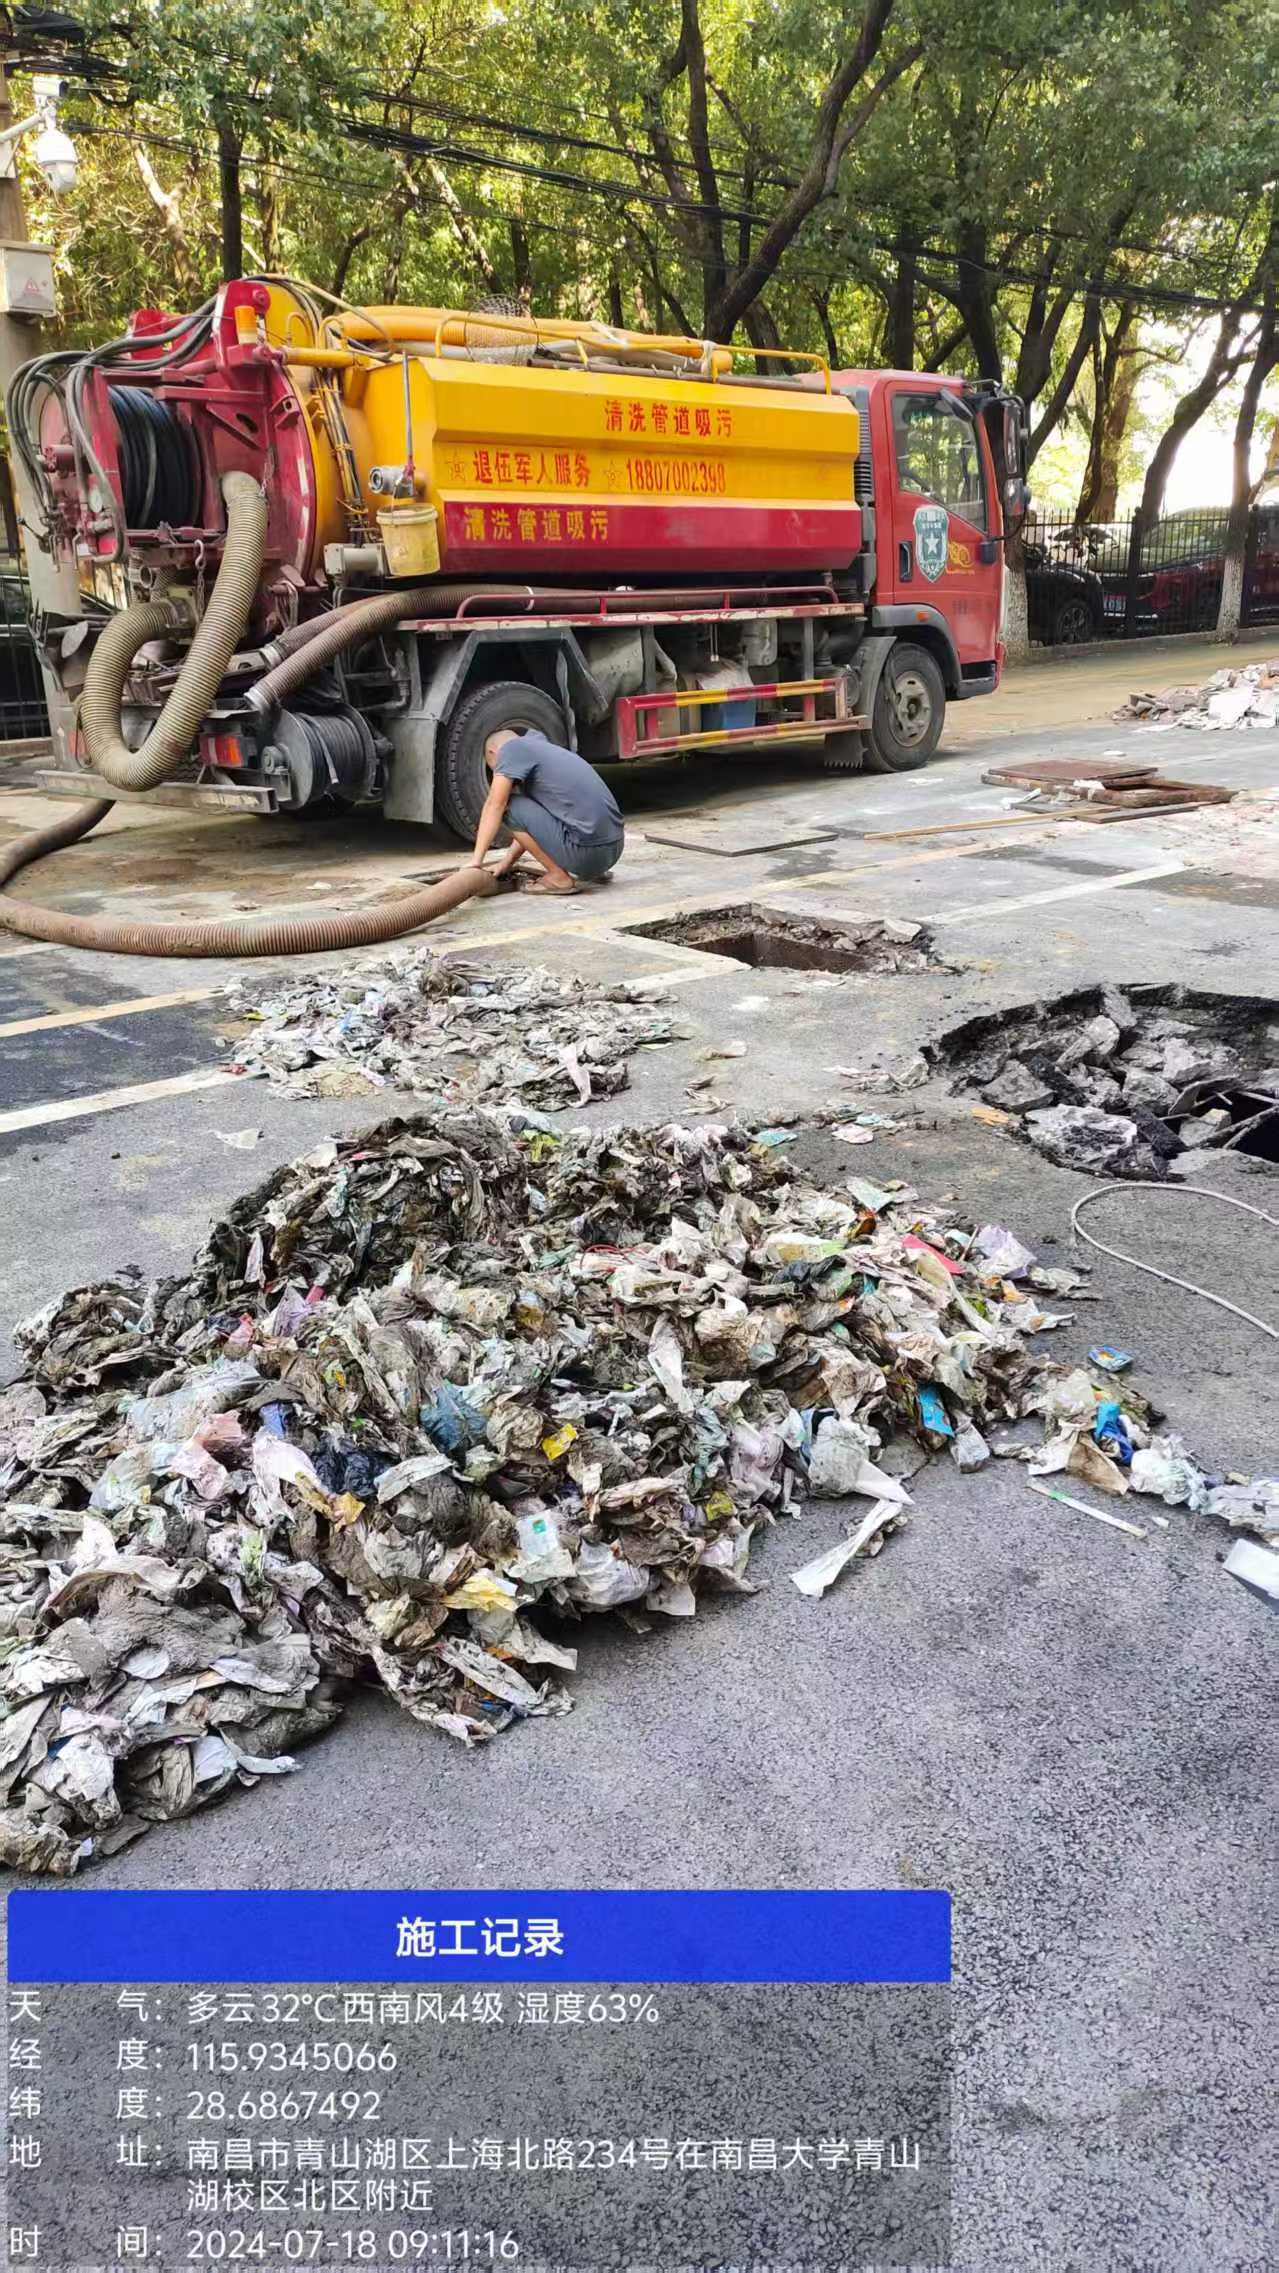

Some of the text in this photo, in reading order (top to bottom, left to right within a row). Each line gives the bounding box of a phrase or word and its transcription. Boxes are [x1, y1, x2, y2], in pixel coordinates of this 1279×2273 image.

[604, 400, 732, 438] 清洗管道吸污
[473, 449, 591, 488] 退伍军人服务
[464, 507, 608, 541] 清洗管道吸污
